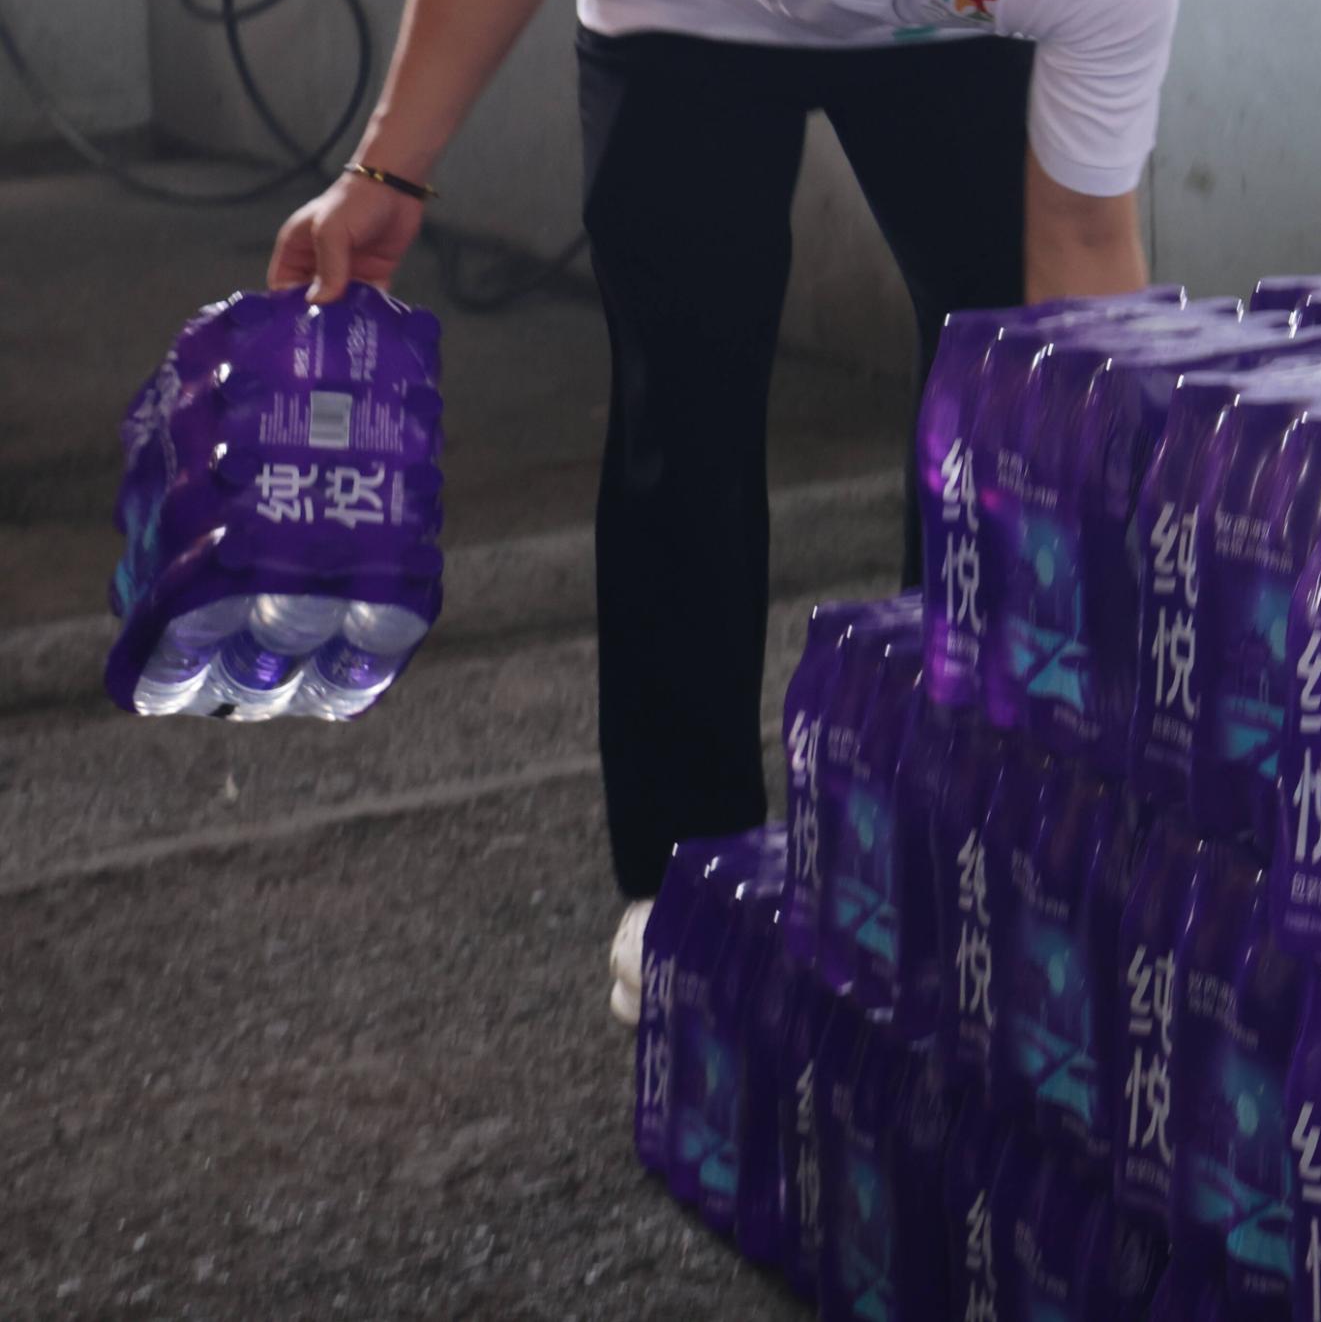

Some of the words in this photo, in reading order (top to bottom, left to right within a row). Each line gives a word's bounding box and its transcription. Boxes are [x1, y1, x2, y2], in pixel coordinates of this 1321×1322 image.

[255, 462, 386, 529] 纯悦
[940, 437, 985, 634] 纯悦
[1150, 501, 1199, 720] 纯悦
[955, 828, 994, 1030] 纯悦
[1124, 945, 1176, 1166] 纯悦
